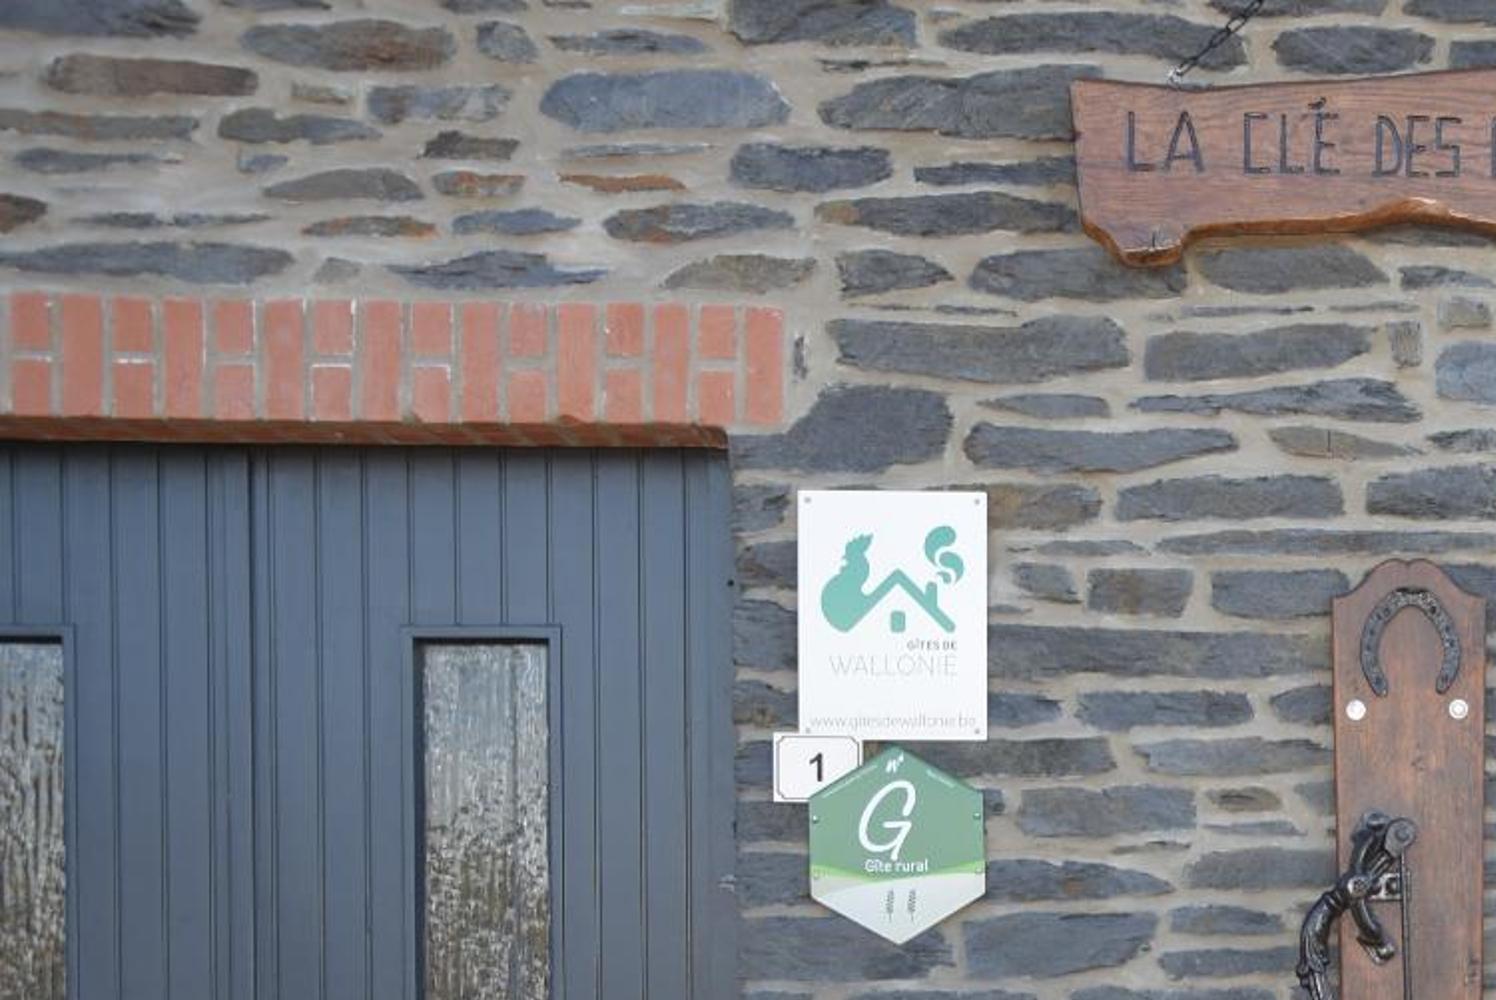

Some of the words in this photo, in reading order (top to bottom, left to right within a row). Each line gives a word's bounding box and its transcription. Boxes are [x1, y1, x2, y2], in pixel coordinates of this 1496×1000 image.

[1125, 110, 1205, 173] LA
[1242, 96, 1342, 176] CLÉ
[1371, 113, 1463, 179] DES
[828, 654, 958, 676] WALLONIE
[808, 752, 823, 782] 1
[857, 779, 917, 861] G
[896, 858, 928, 872] rural
